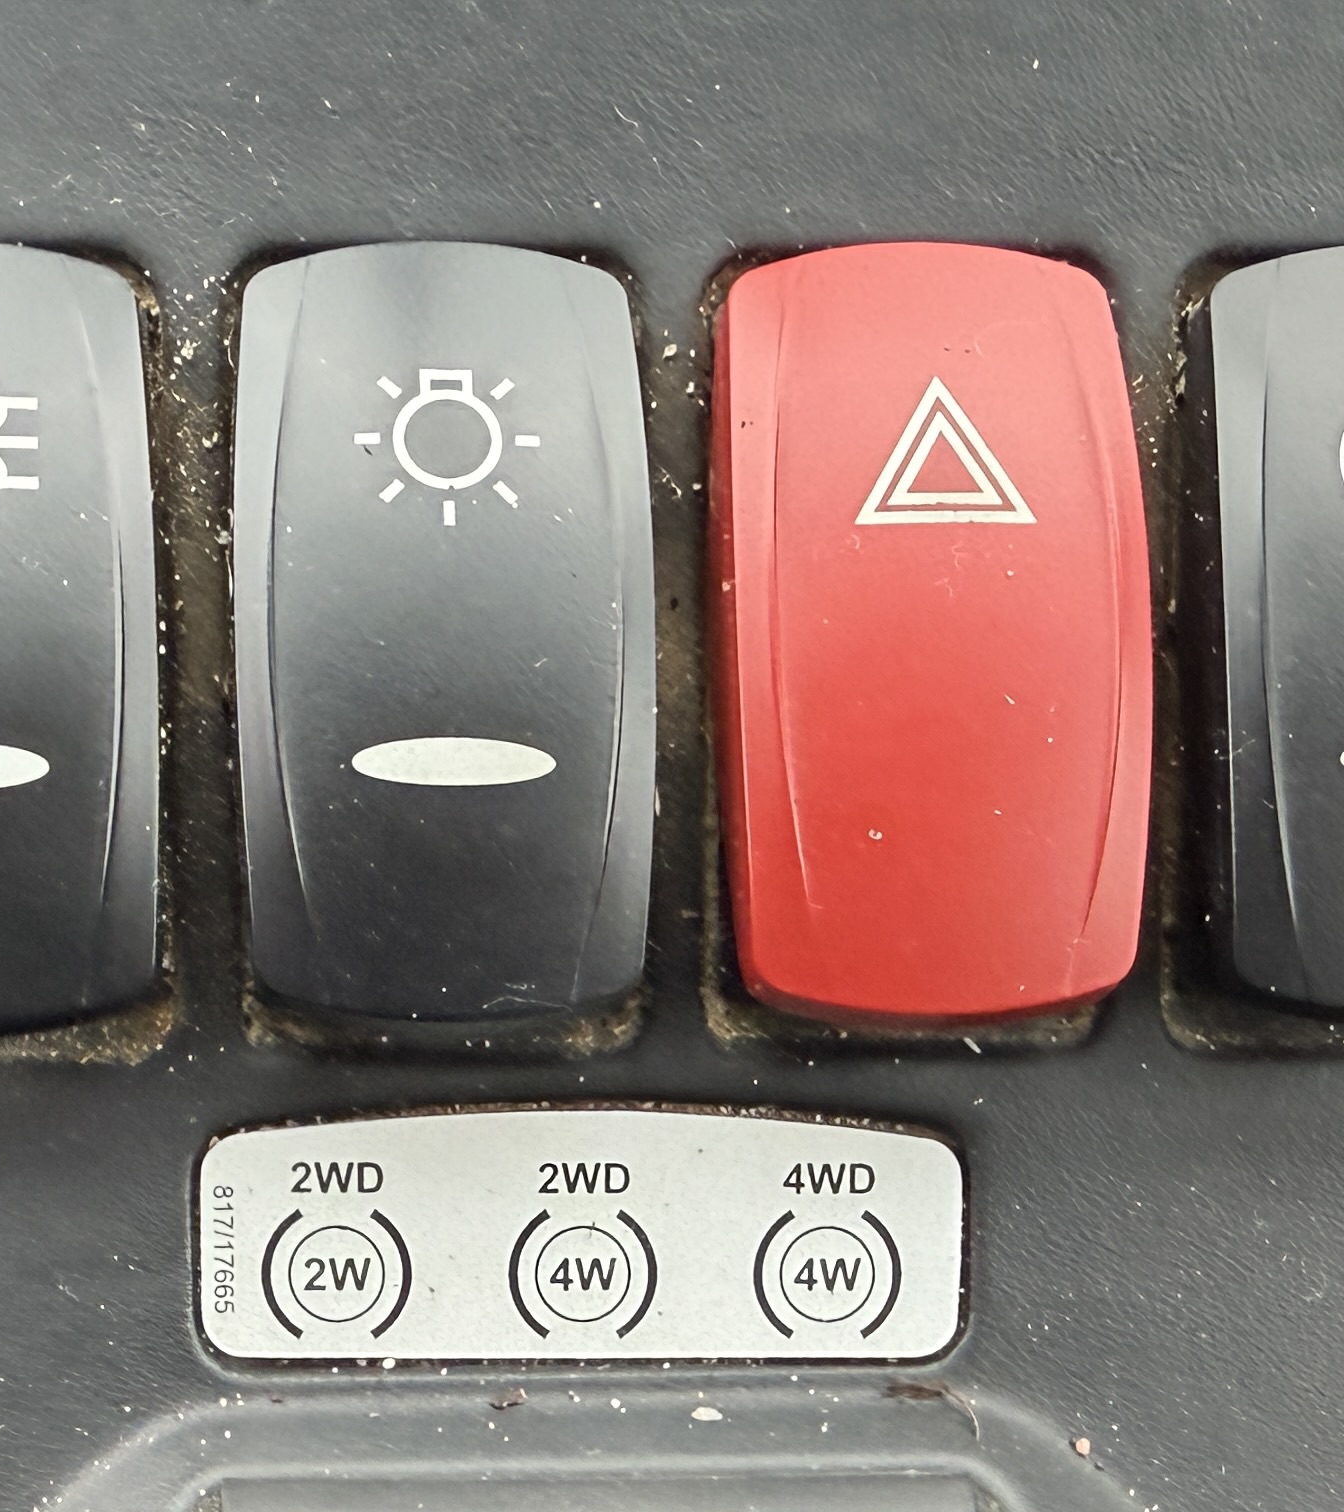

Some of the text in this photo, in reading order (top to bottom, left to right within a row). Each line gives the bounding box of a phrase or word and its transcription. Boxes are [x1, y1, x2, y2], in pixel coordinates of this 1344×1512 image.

[290, 1161, 384, 1194] 2WD
[538, 1162, 631, 1195] 2WD
[782, 1162, 876, 1195] 4WD
[212, 1184, 236, 1315] 817/17665
[303, 1257, 372, 1292] 2W
[549, 1257, 617, 1292] 4W
[793, 1257, 862, 1292] 4W
